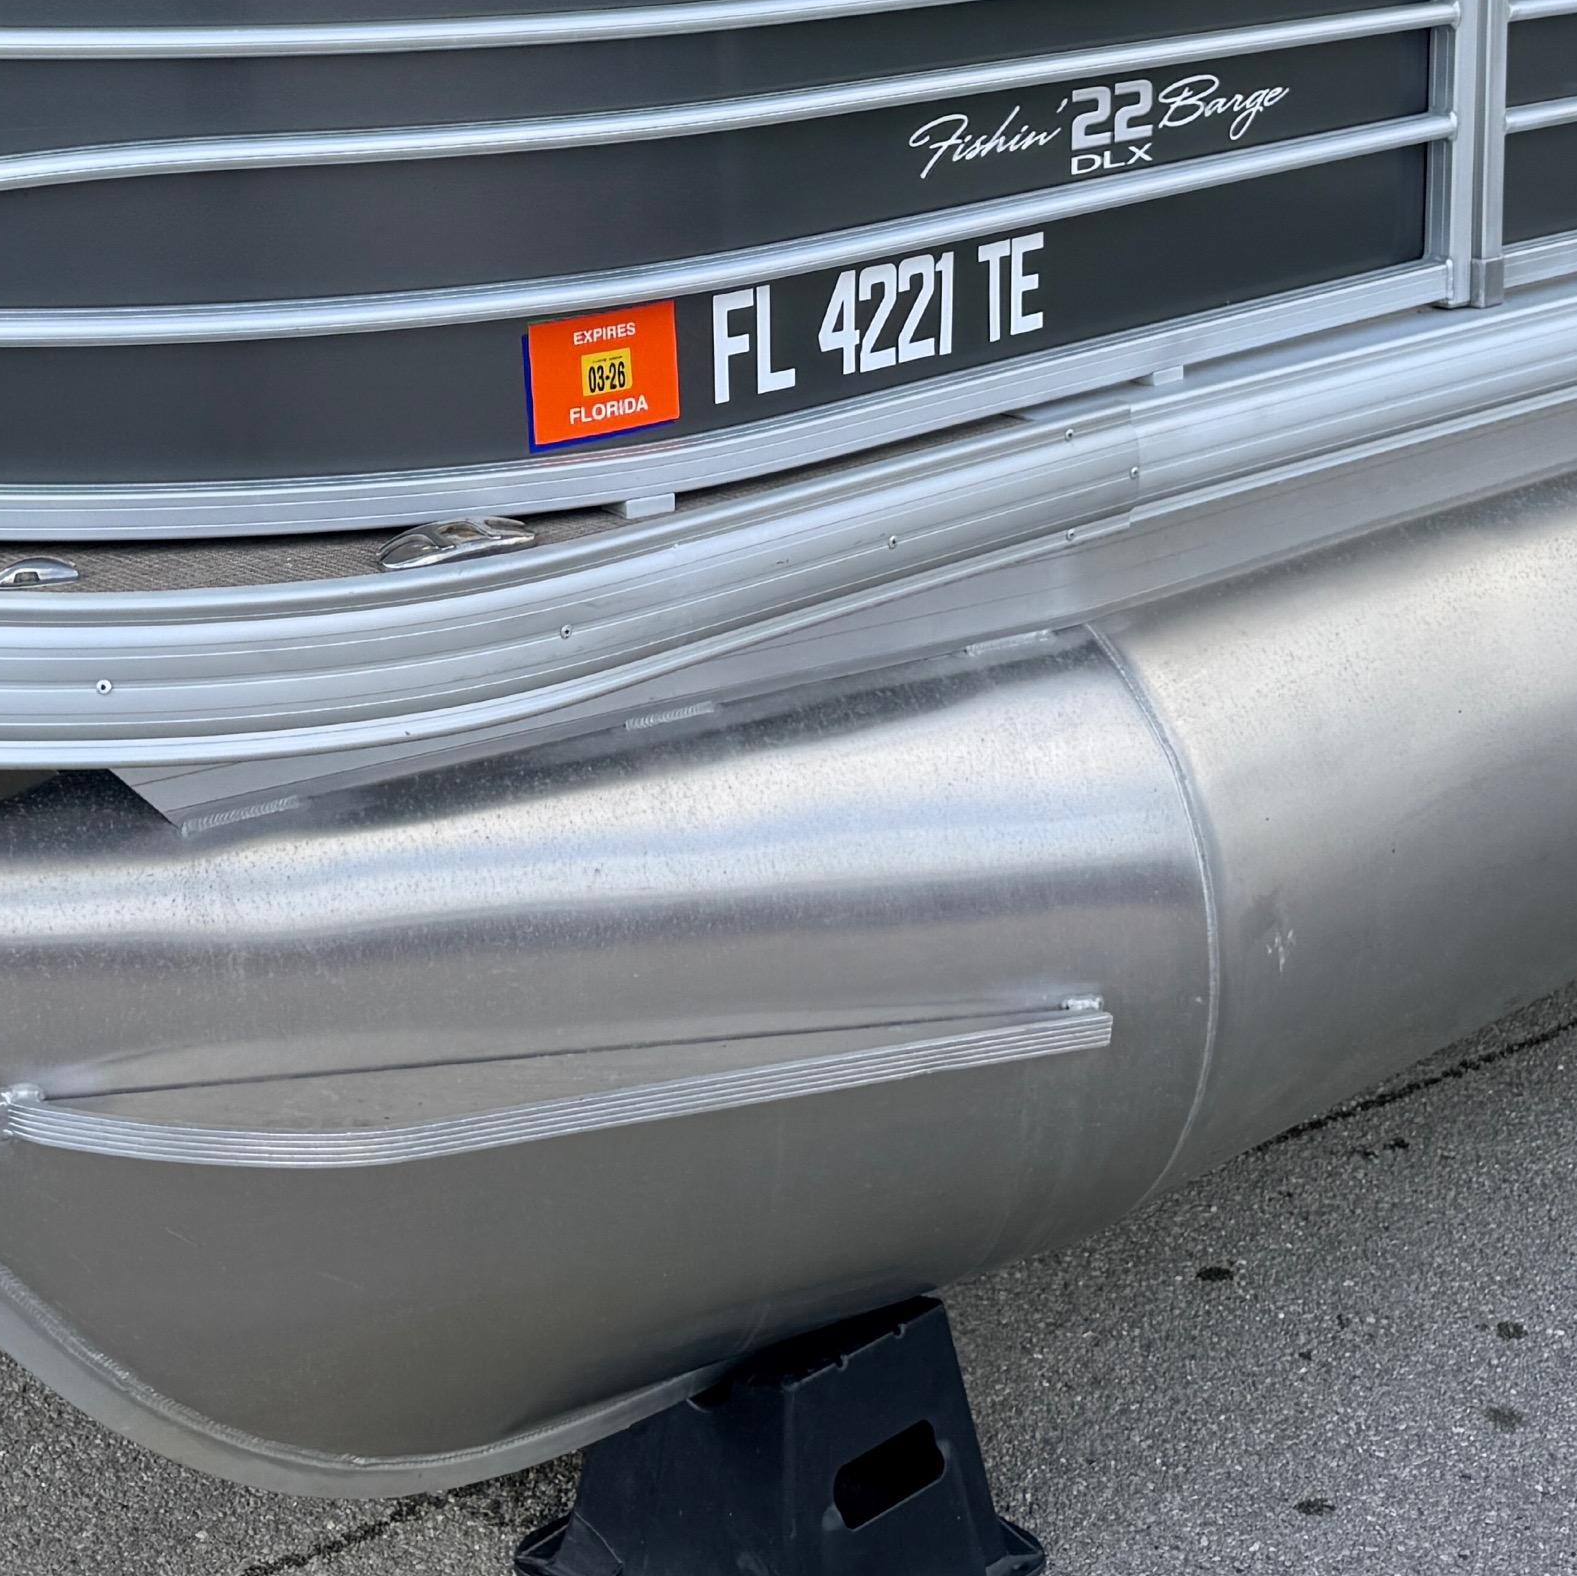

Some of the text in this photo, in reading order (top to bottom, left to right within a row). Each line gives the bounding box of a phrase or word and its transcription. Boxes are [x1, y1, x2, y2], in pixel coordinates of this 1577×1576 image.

[908, 74, 1289, 179] Fishin' 22 Barge
[1070, 142, 1153, 175] DLX
[573, 321, 636, 345] EXPIRES
[712, 231, 1044, 404] FL 4221 TE
[588, 361, 626, 393] 03-26
[569, 394, 649, 425] FLORIDA
